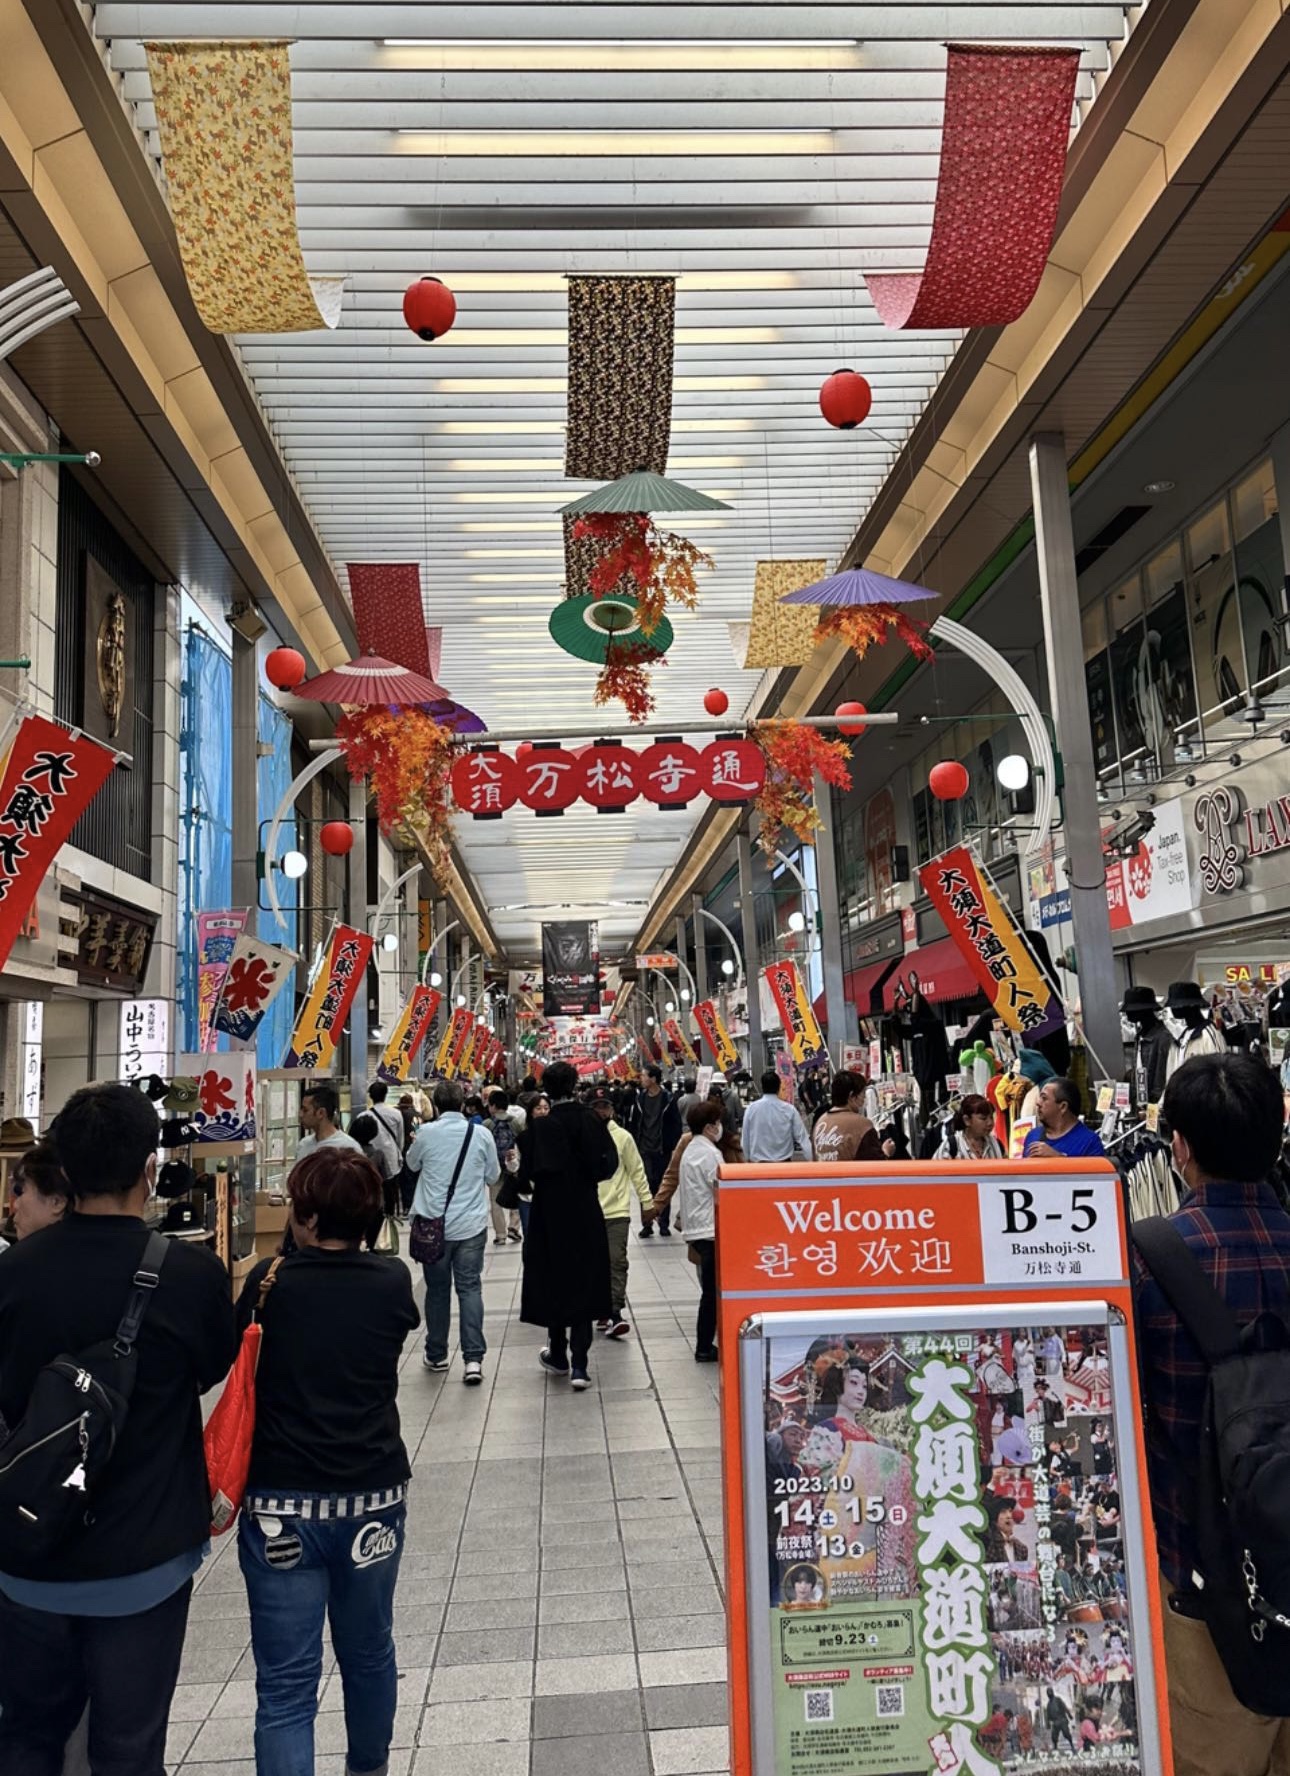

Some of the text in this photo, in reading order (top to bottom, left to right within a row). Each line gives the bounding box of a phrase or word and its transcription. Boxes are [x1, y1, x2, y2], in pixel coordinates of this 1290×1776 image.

[469, 750, 759, 809] 大須 万松寺通
[1157, 852, 1184, 870] Tax-free
[1168, 870, 1186, 885] Shop
[939, 868, 1048, 1030] 大須大道町人祭
[773, 1197, 936, 1234] Welcome
[999, 1188, 1098, 1235] B-5
[754, 1237, 953, 1279] 환영 欢迎
[1010, 1240, 1096, 1256] Banshoji-St.
[1023, 1260, 1082, 1276] 万松寺通
[902, 1334, 974, 1355] 第44回
[774, 1475, 853, 1494] 2023.10
[774, 1499, 815, 1528] 14
[845, 1495, 885, 1523] 15
[816, 1535, 846, 1557] 13
[834, 1633, 866, 1645] 9.23
